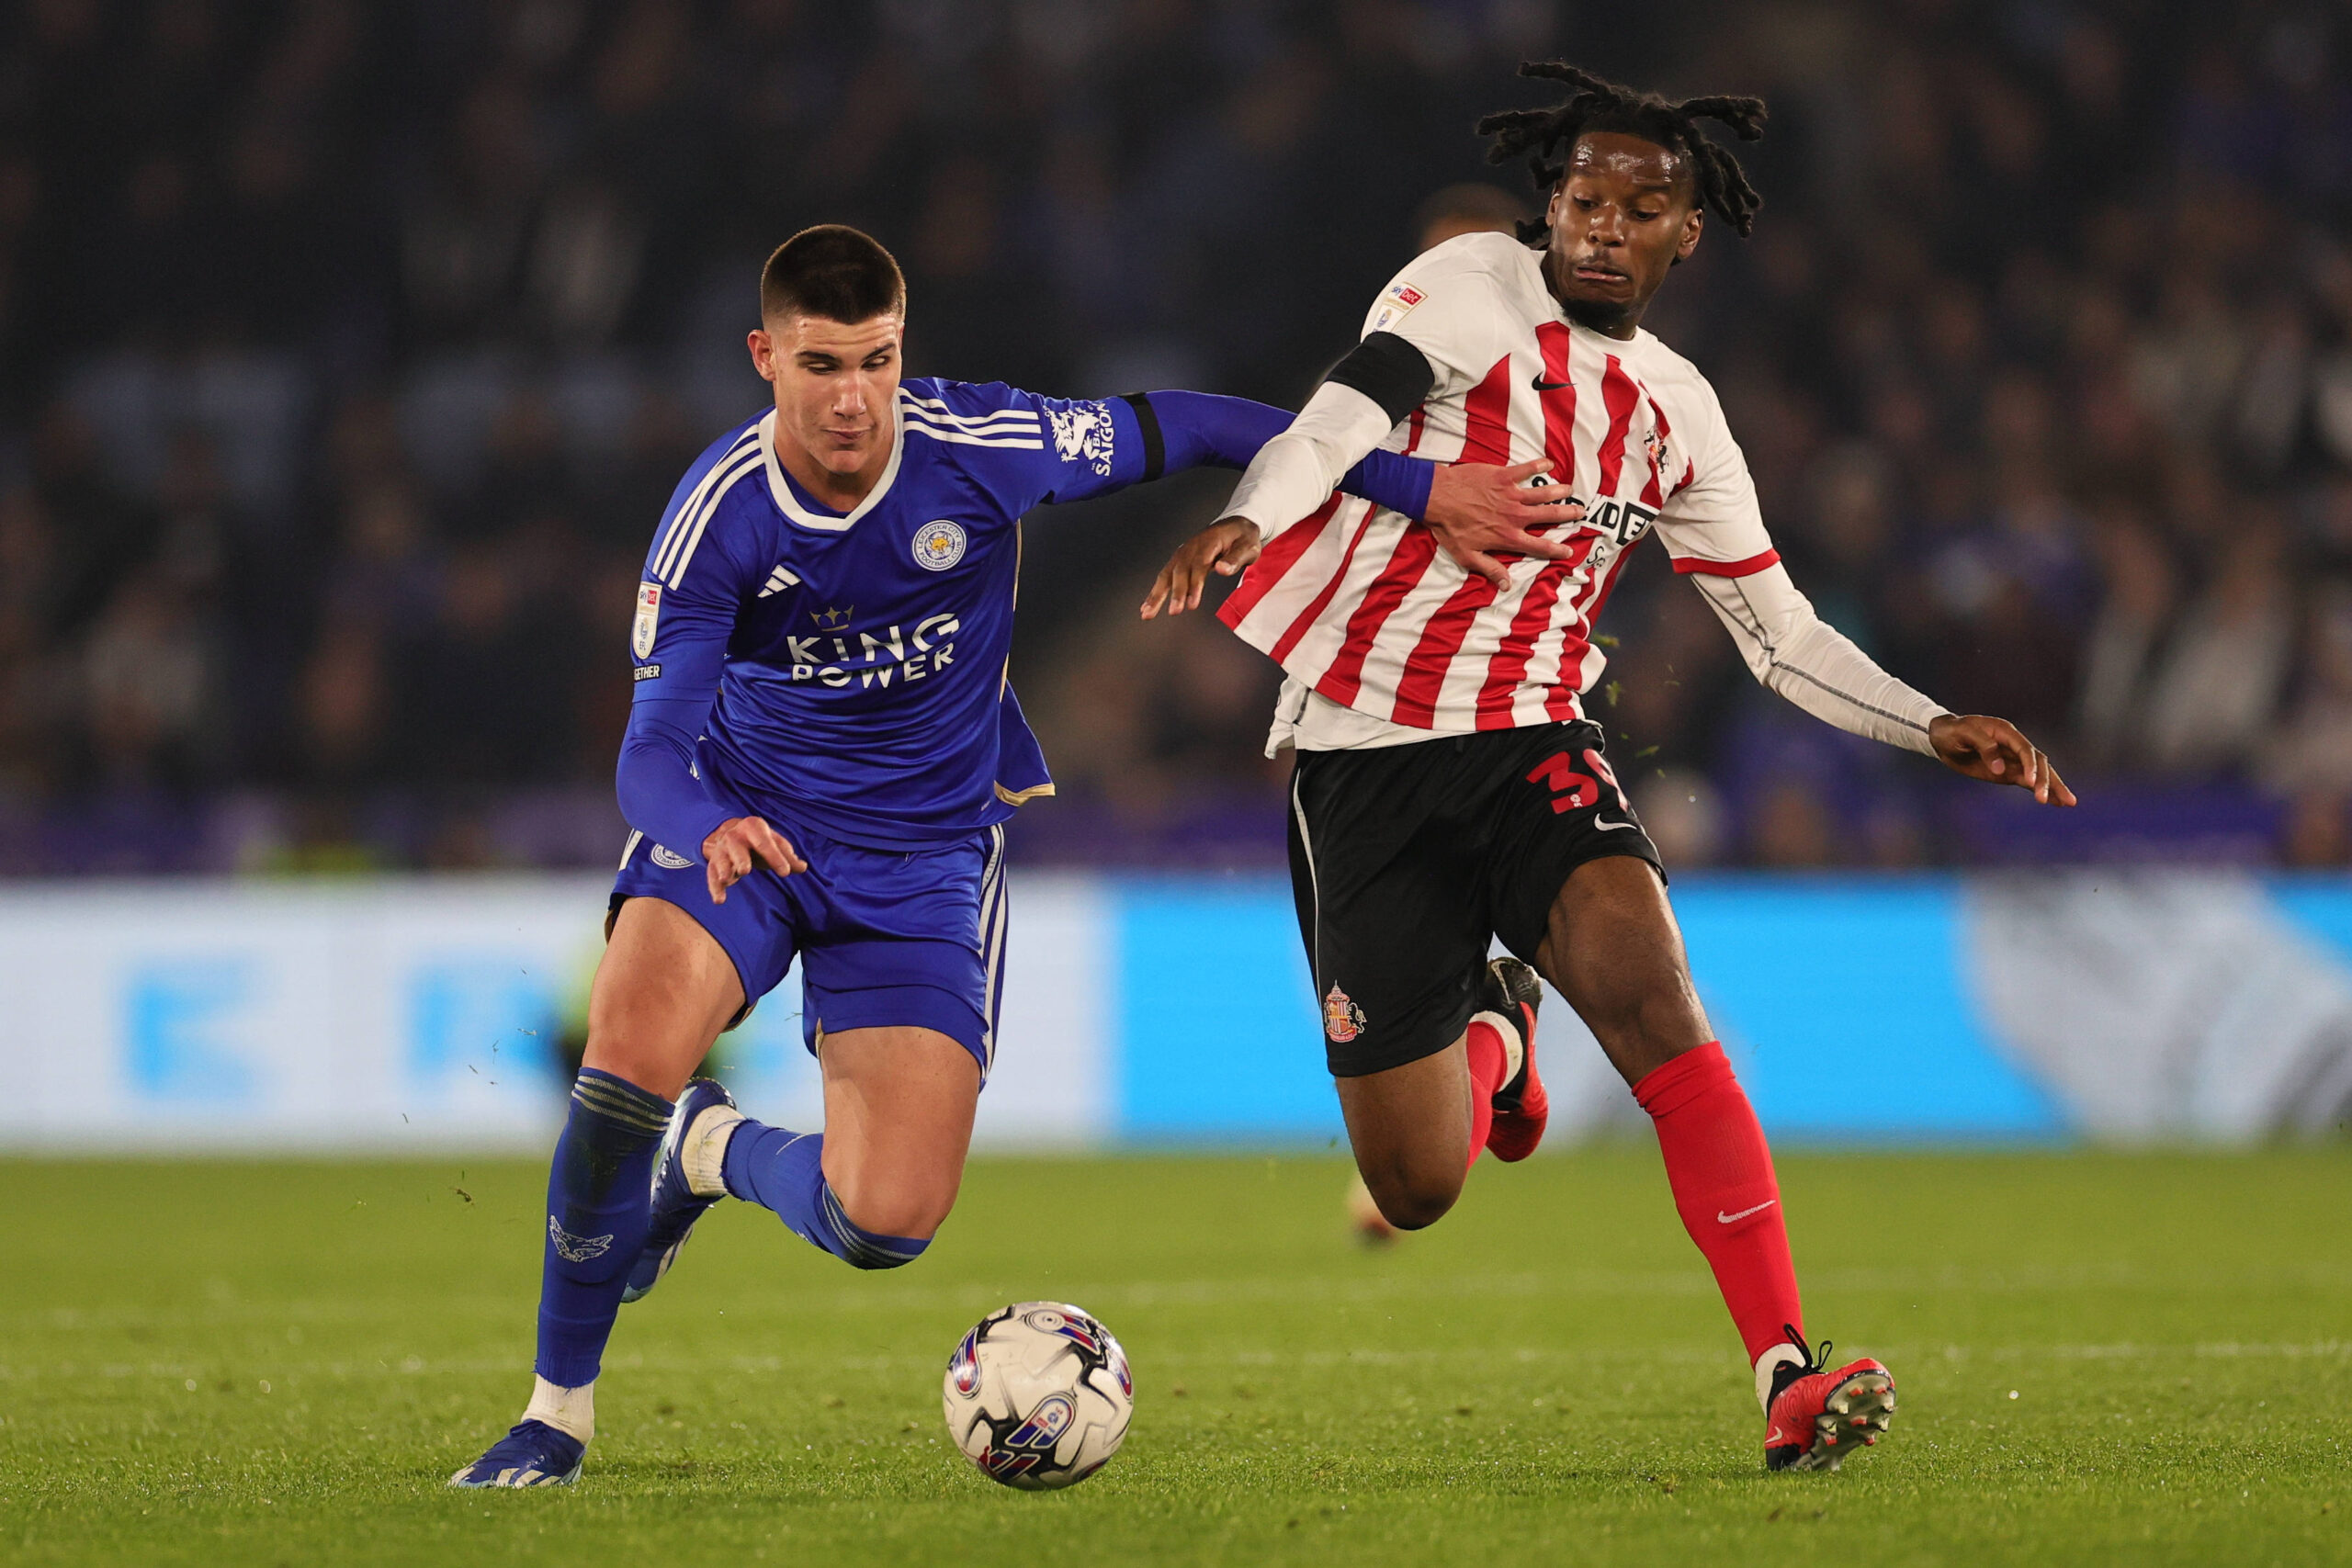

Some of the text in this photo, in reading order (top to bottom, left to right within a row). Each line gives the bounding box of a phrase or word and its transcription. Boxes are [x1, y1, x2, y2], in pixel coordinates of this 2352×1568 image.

[1094, 402, 1114, 476] SAIGON
[918, 525, 961, 549] LEICESTER CITY
[919, 541, 962, 566] FOOTBALL CLUB
[786, 613, 960, 664] KING
[792, 643, 956, 689] POWER
